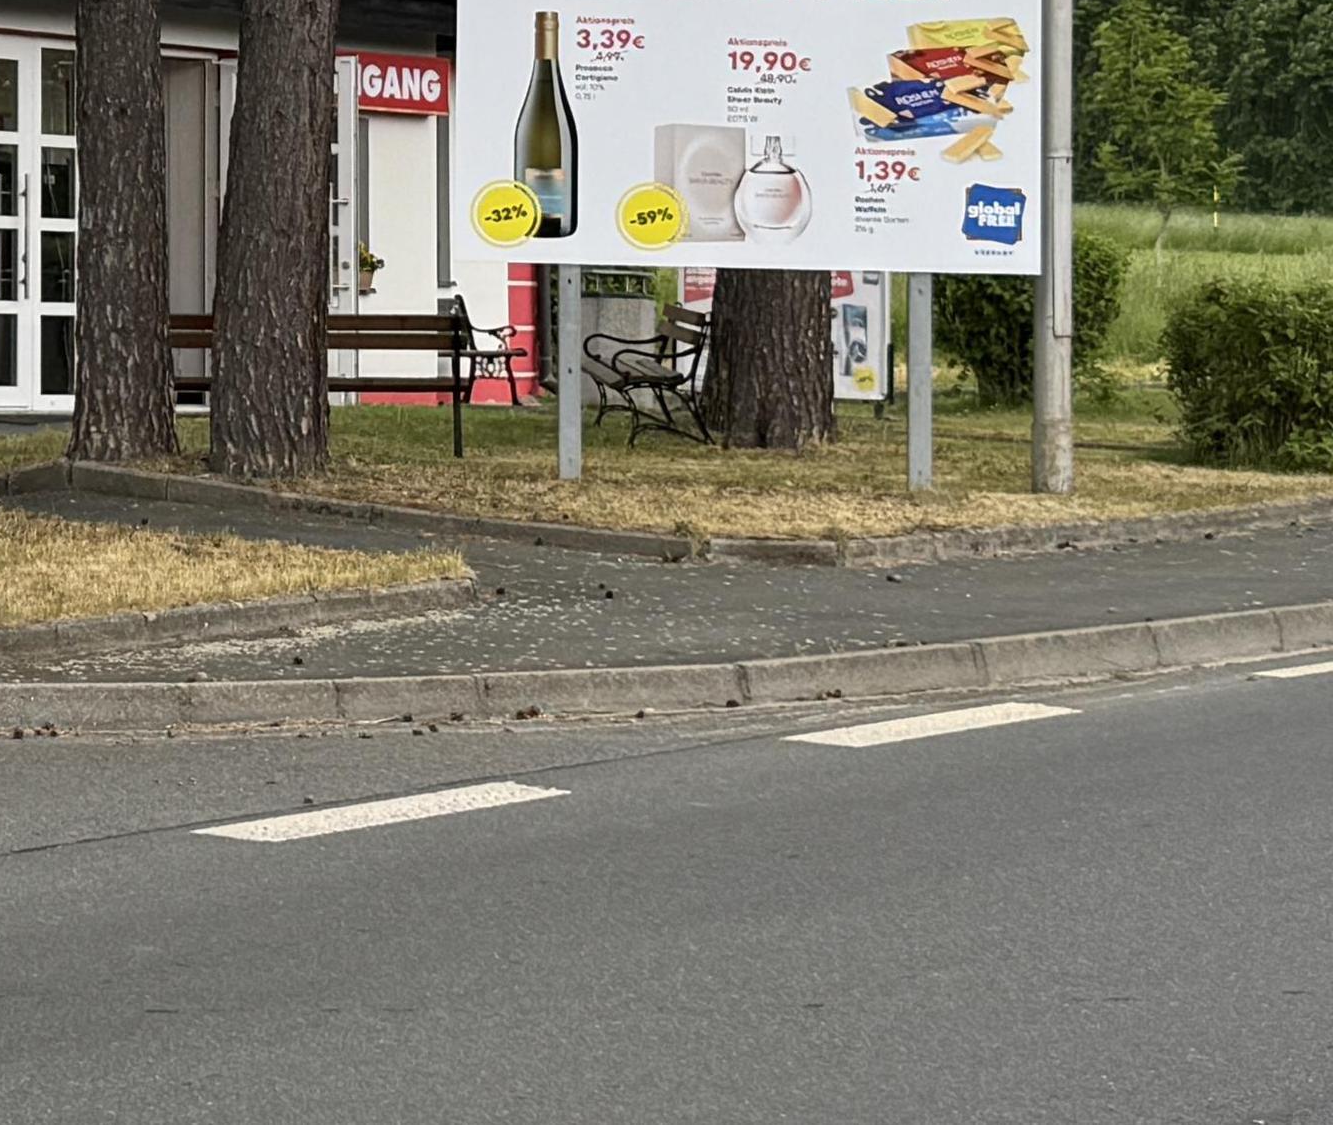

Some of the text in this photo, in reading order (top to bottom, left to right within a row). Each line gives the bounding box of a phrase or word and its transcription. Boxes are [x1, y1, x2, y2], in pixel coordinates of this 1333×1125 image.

[576, 28, 646, 51] 3,39€
[727, 50, 812, 74] 19,90€
[357, 63, 441, 103] GANG
[854, 160, 921, 183] 1,39€
[485, 203, 528, 223] -32%
[629, 206, 674, 226] -59%
[967, 200, 1020, 218] global
